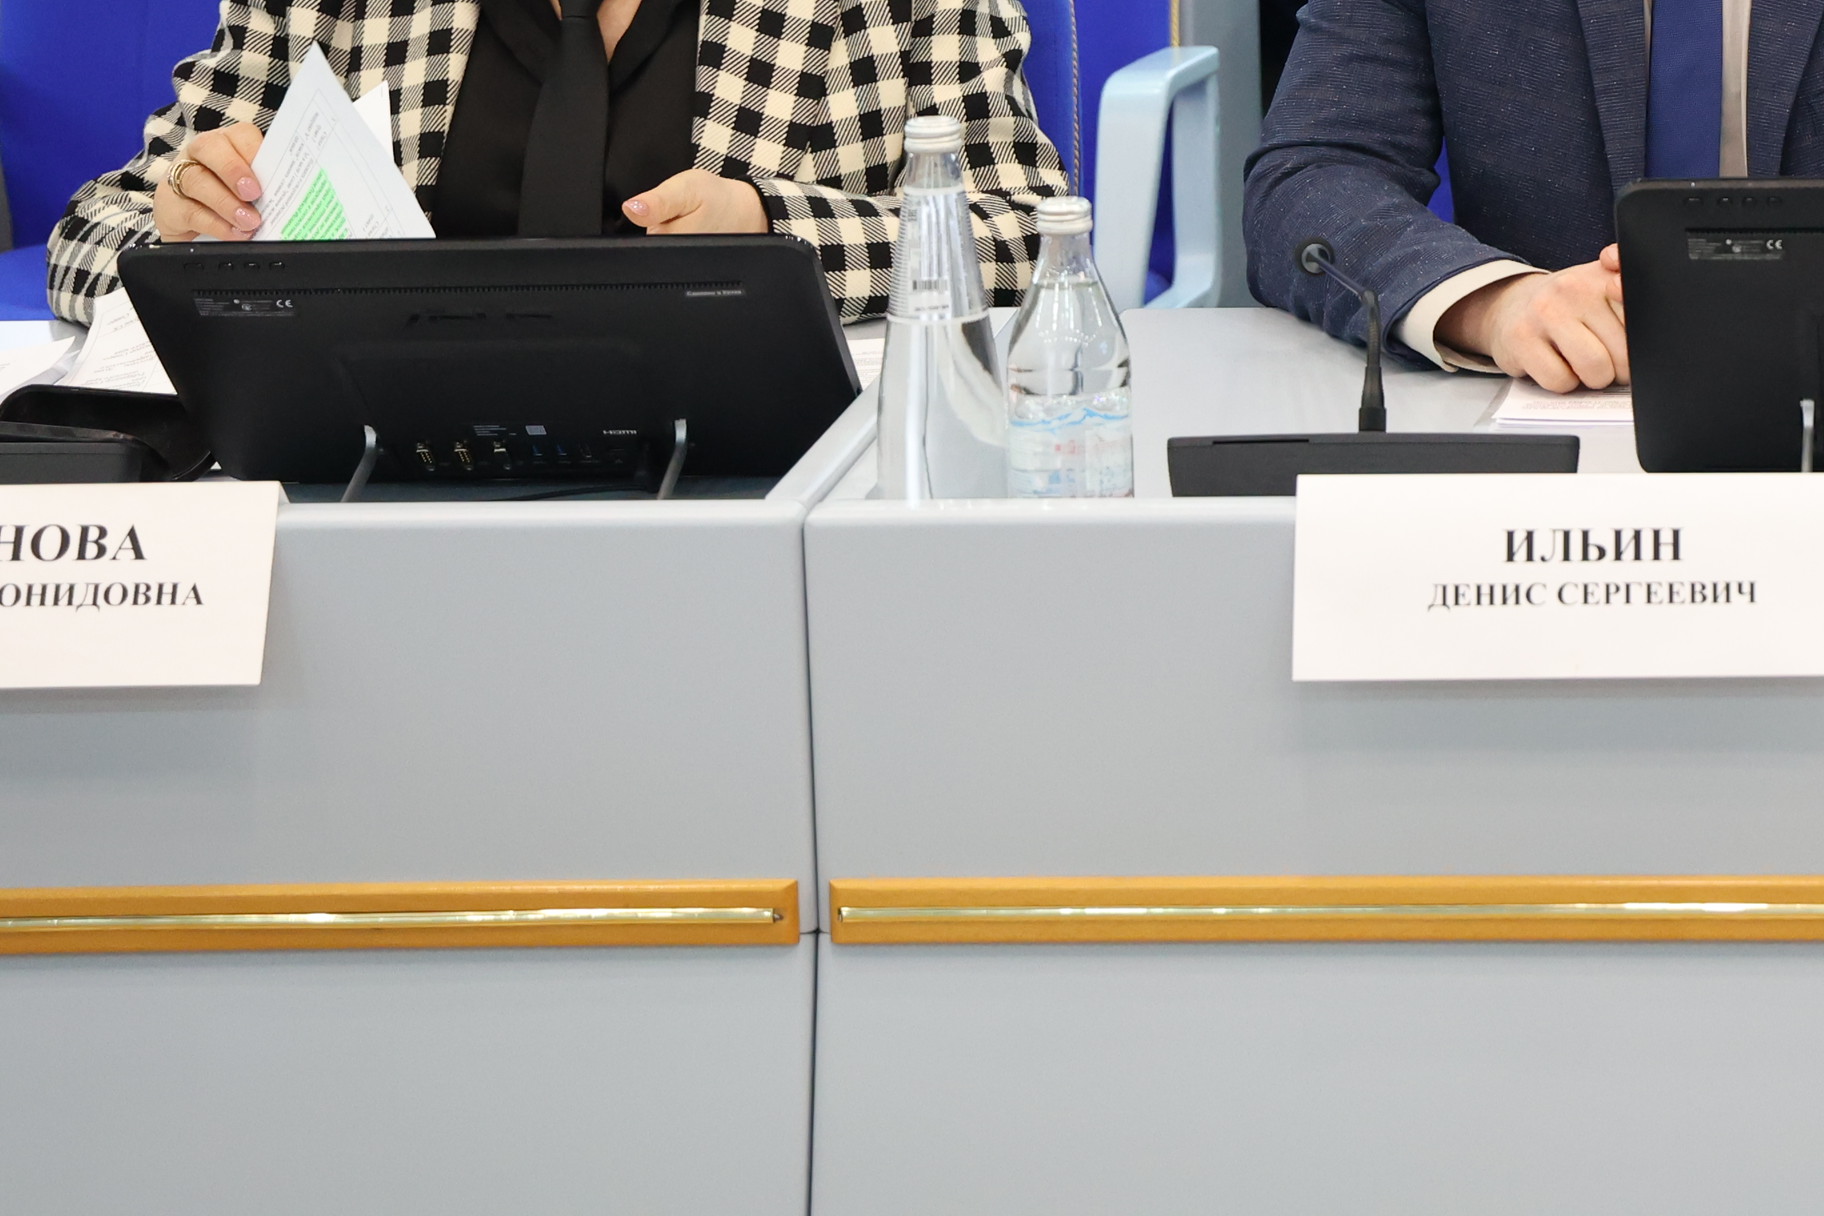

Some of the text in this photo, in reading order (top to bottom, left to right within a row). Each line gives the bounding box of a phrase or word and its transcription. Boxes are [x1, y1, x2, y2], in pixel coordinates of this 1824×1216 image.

[0, 523, 148, 563] НОВА
[1502, 527, 1683, 564] ИЛЬИН
[0, 582, 205, 612] ОНИДОВНА
[1427, 581, 1758, 612] ДЕНИС СЕРГЕЕВИЧ
